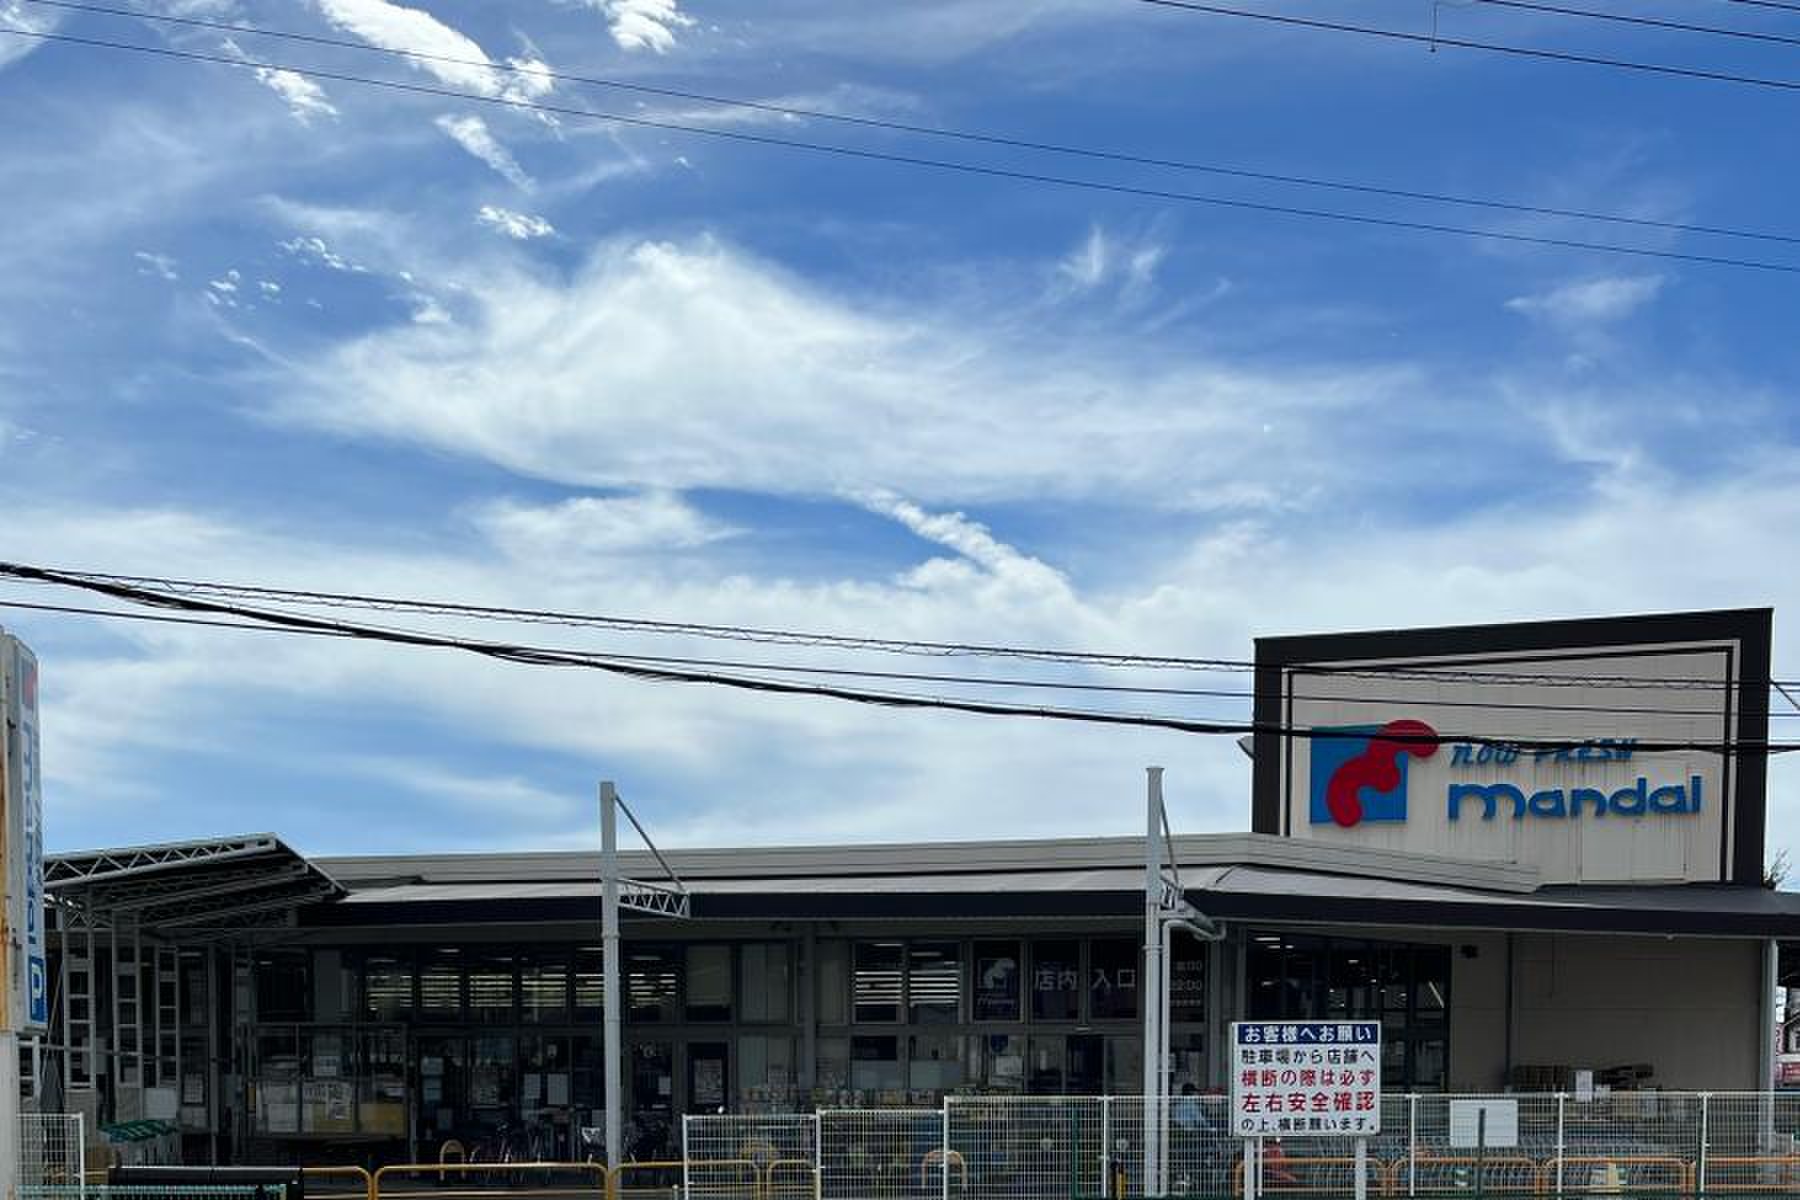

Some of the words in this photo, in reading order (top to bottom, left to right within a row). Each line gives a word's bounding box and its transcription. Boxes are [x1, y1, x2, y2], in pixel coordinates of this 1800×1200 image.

[1245, 1025, 1372, 1042] お客様へお願い
[1241, 1049, 1375, 1065] 駐車場から店舗へ
[1241, 1091, 1375, 1113] 左右安全確認
